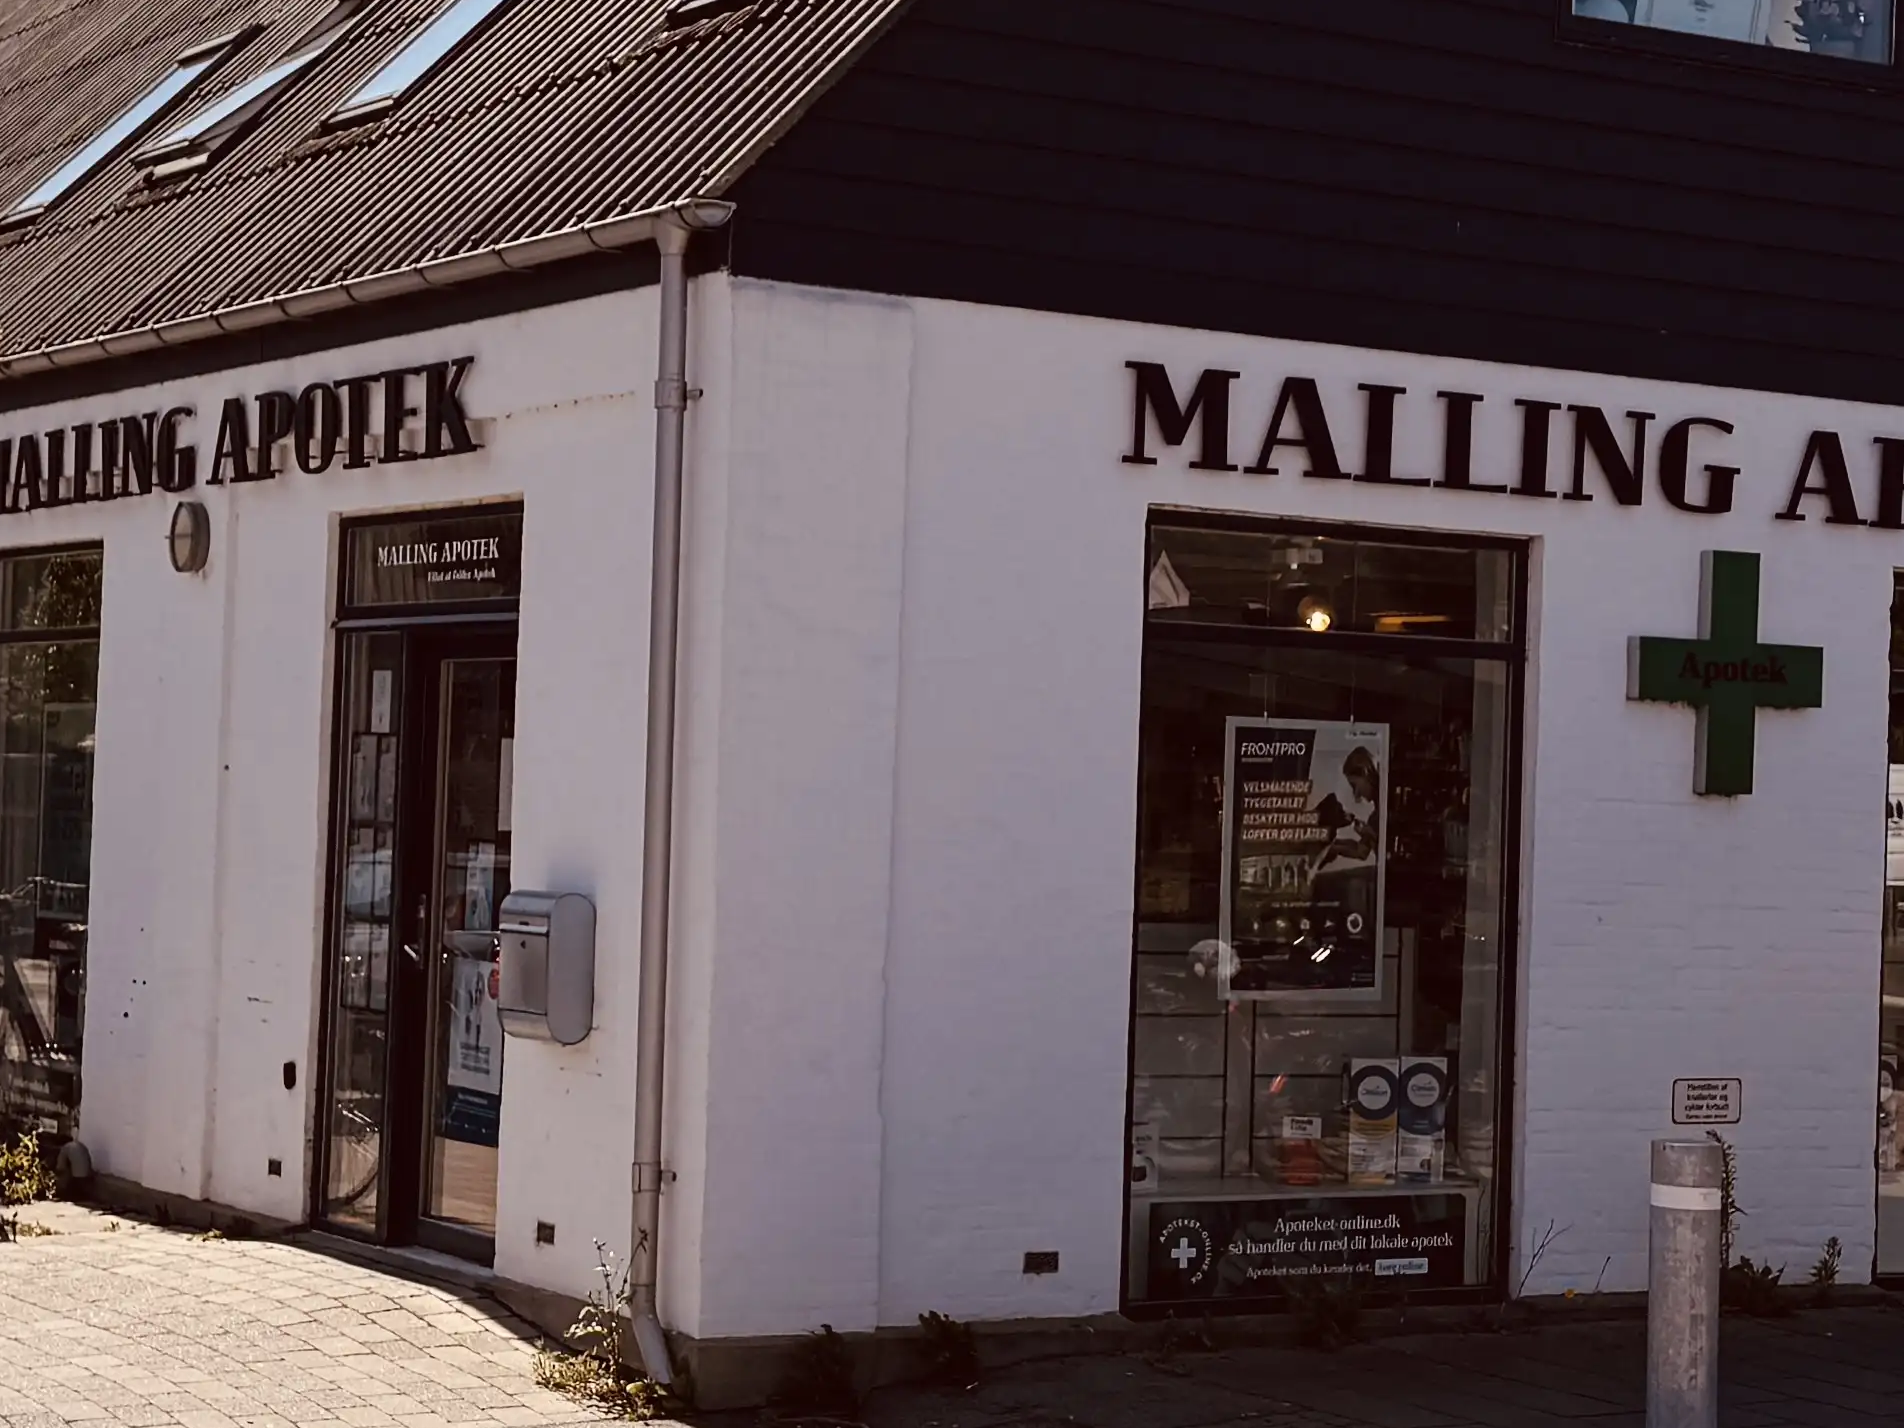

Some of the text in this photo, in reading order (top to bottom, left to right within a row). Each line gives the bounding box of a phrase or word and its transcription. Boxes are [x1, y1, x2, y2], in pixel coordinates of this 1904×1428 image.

[206, 356, 486, 485] APOTEK
[1121, 360, 1742, 515] MALLING
[377, 536, 500, 568] MALLING APOTEK
[1677, 651, 1789, 689] Apotek
[1240, 742, 1306, 756] FRONTPRO
[1273, 1214, 1401, 1236] Apoteket-online.dk
[1227, 1239, 1244, 1255] så
[1246, 1237, 1296, 1254] handler
[1299, 1238, 1316, 1253] du
[1319, 1236, 1347, 1252] med
[1350, 1235, 1367, 1250] dit
[1370, 1233, 1409, 1249] lokale
[1411, 1232, 1454, 1251] apotek
